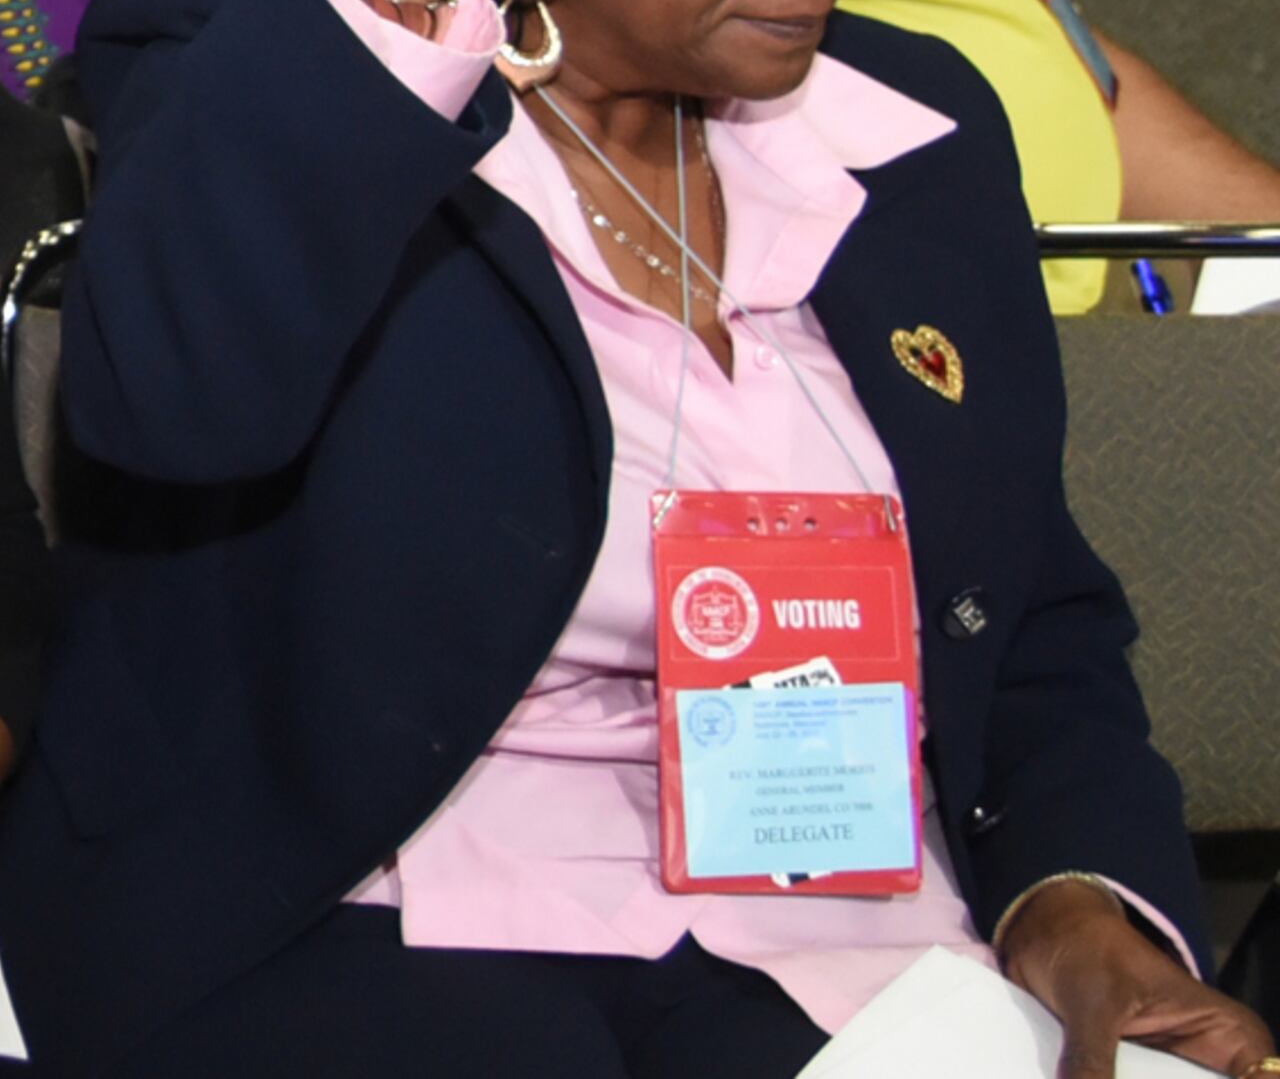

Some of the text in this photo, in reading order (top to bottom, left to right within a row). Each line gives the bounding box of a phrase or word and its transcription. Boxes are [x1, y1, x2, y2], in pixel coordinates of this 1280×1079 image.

[772, 599, 861, 629] VOTING
[757, 765, 830, 779] MARGUERITE
[754, 823, 854, 845] DELEGATE
